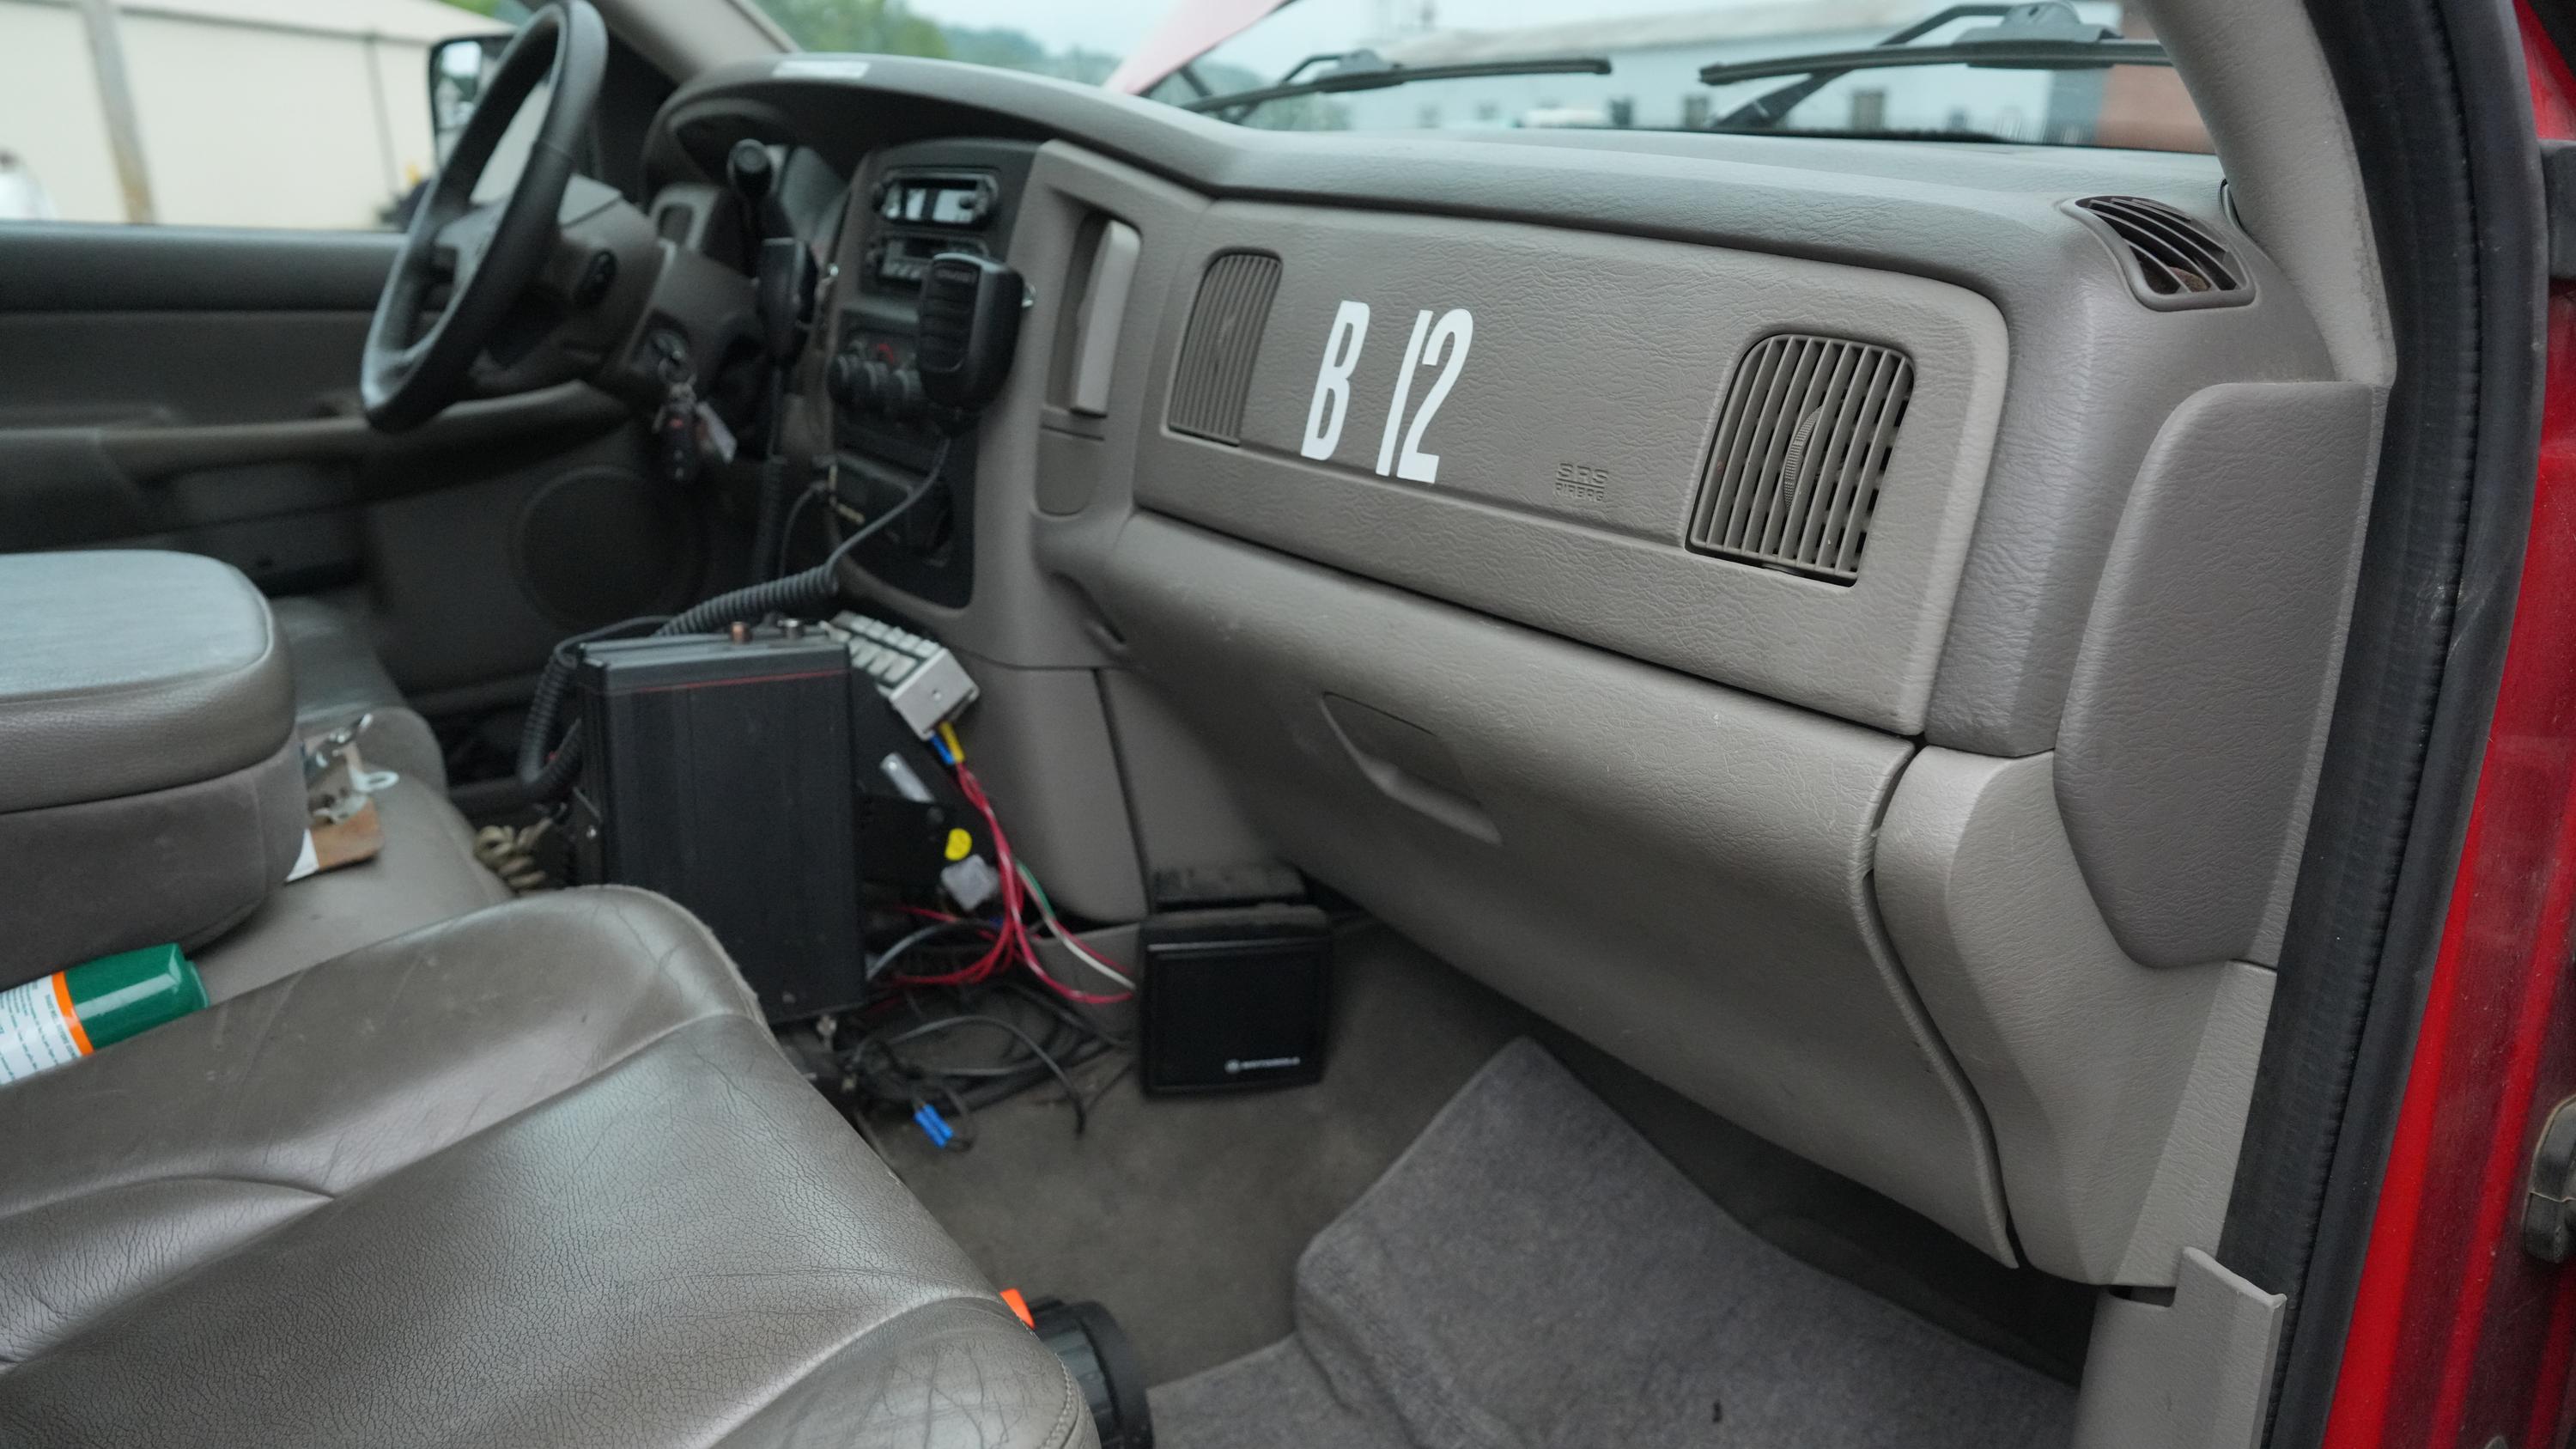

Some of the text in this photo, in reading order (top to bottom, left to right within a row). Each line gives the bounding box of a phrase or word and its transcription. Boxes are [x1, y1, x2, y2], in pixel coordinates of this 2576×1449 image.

[1300, 300, 1474, 484] B 12
[1556, 462, 1609, 484] SRS
